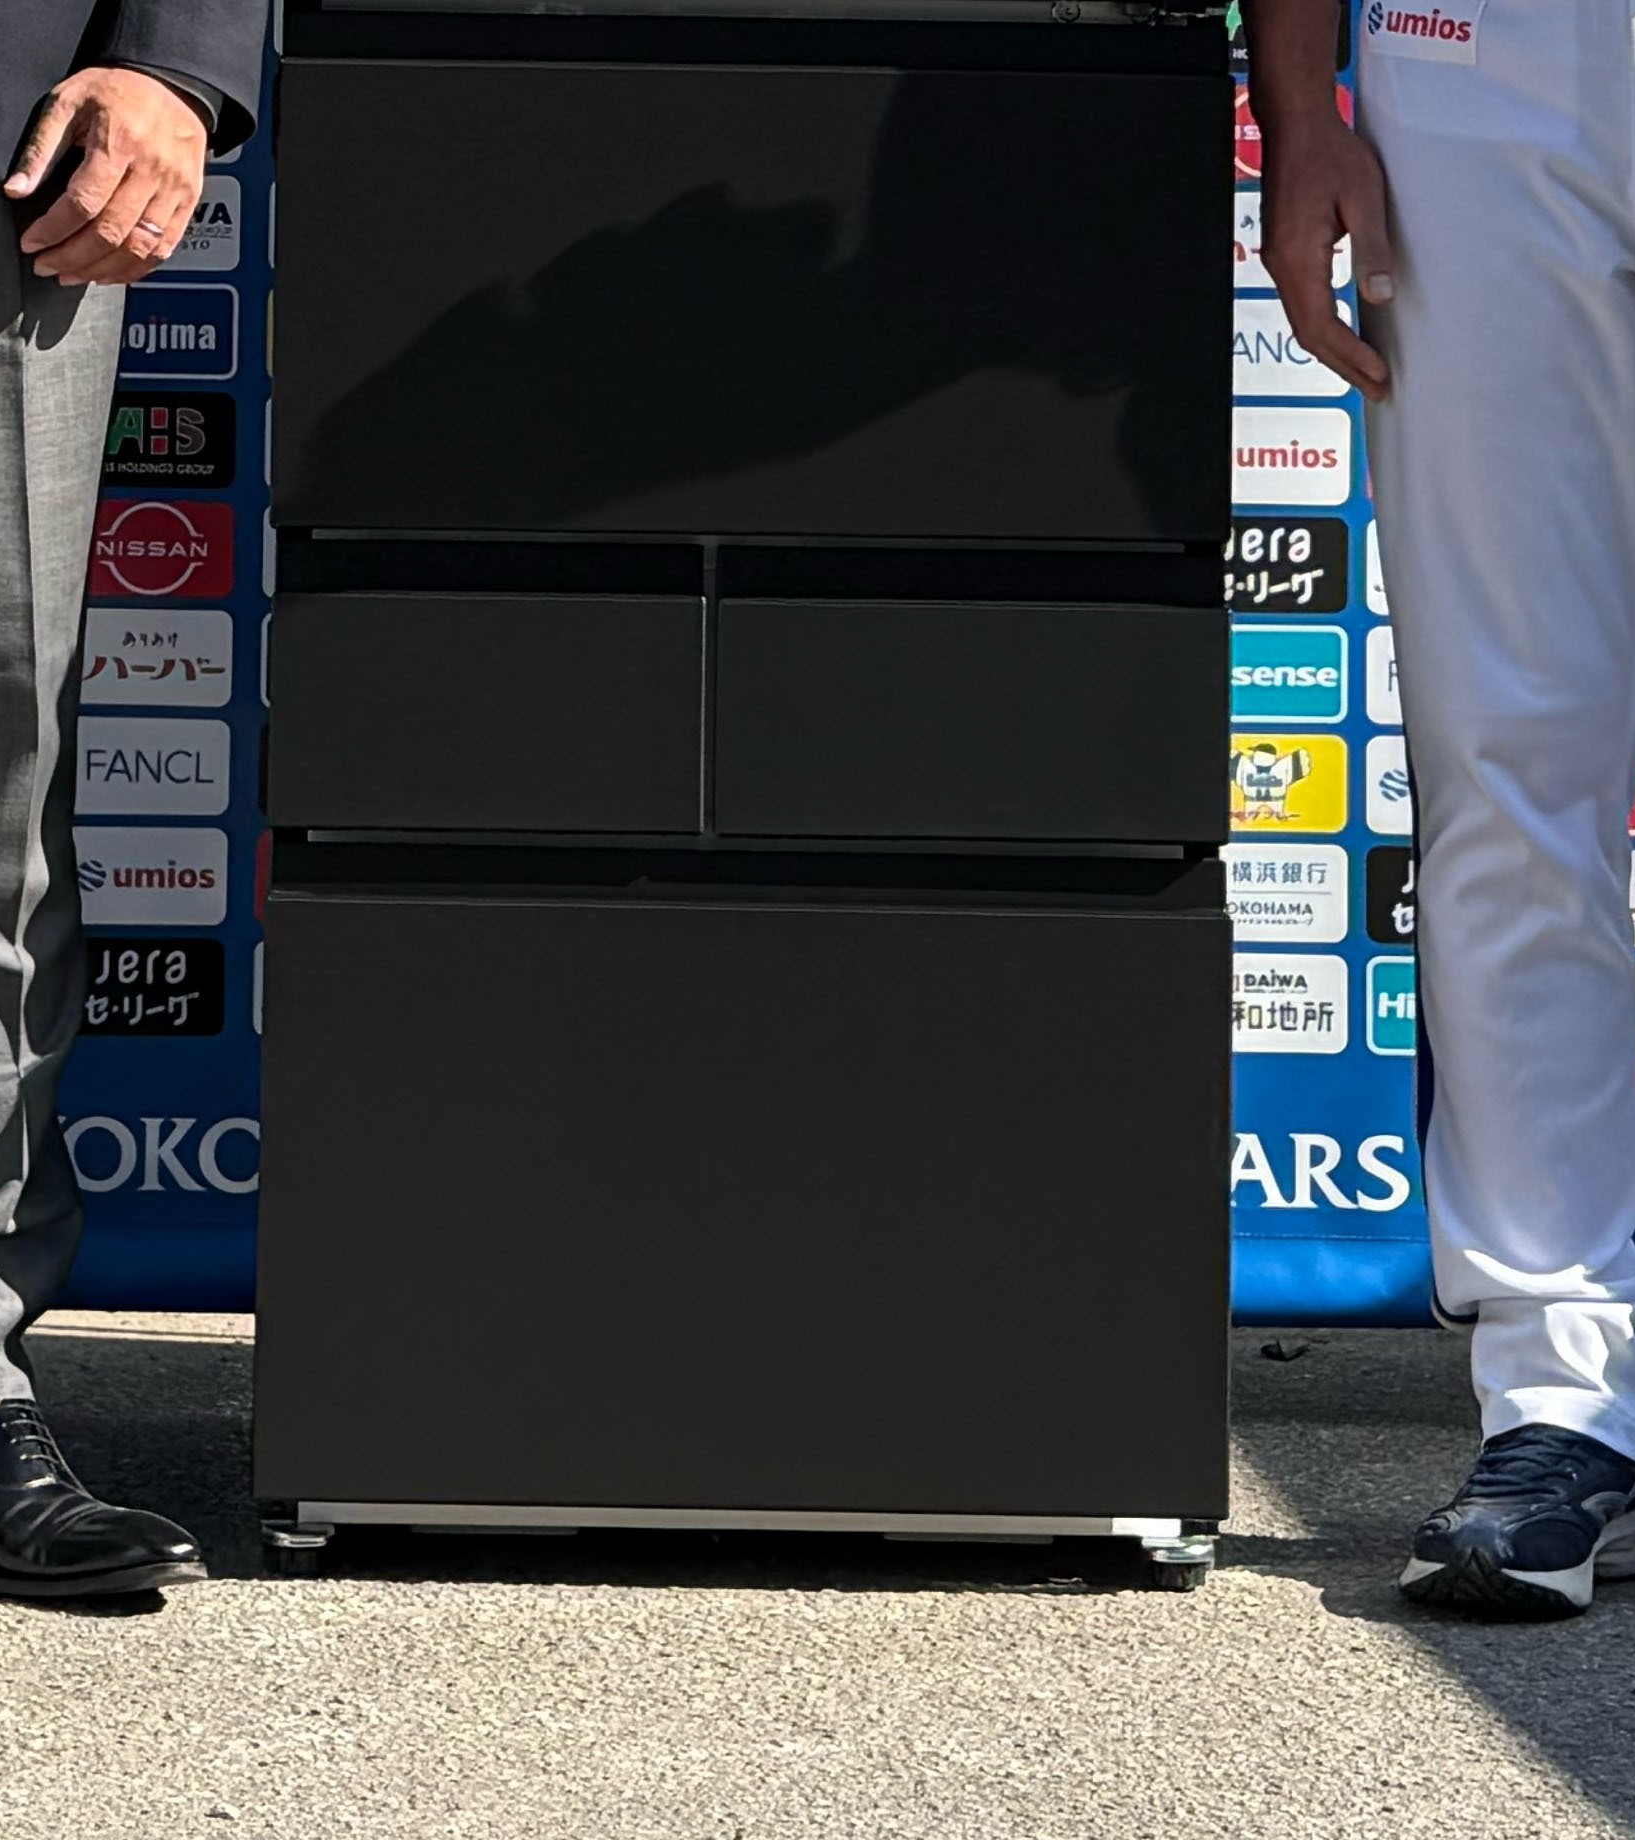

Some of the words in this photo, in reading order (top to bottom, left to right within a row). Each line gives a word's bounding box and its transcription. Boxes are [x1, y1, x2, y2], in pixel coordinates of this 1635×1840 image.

[1386, 9, 1472, 43] umios
[129, 315, 217, 352] ojima
[1237, 439, 1338, 469] umios
[96, 540, 208, 557] NISSAN
[82, 656, 226, 681] ハーバー
[1232, 665, 1339, 688] sense
[86, 748, 214, 784] FANCL
[113, 859, 215, 889] umios
[1232, 861, 1327, 885] 横浜銀行
[1227, 901, 1313, 917] OKOHAMA
[1231, 1002, 1334, 1032] 和地所
